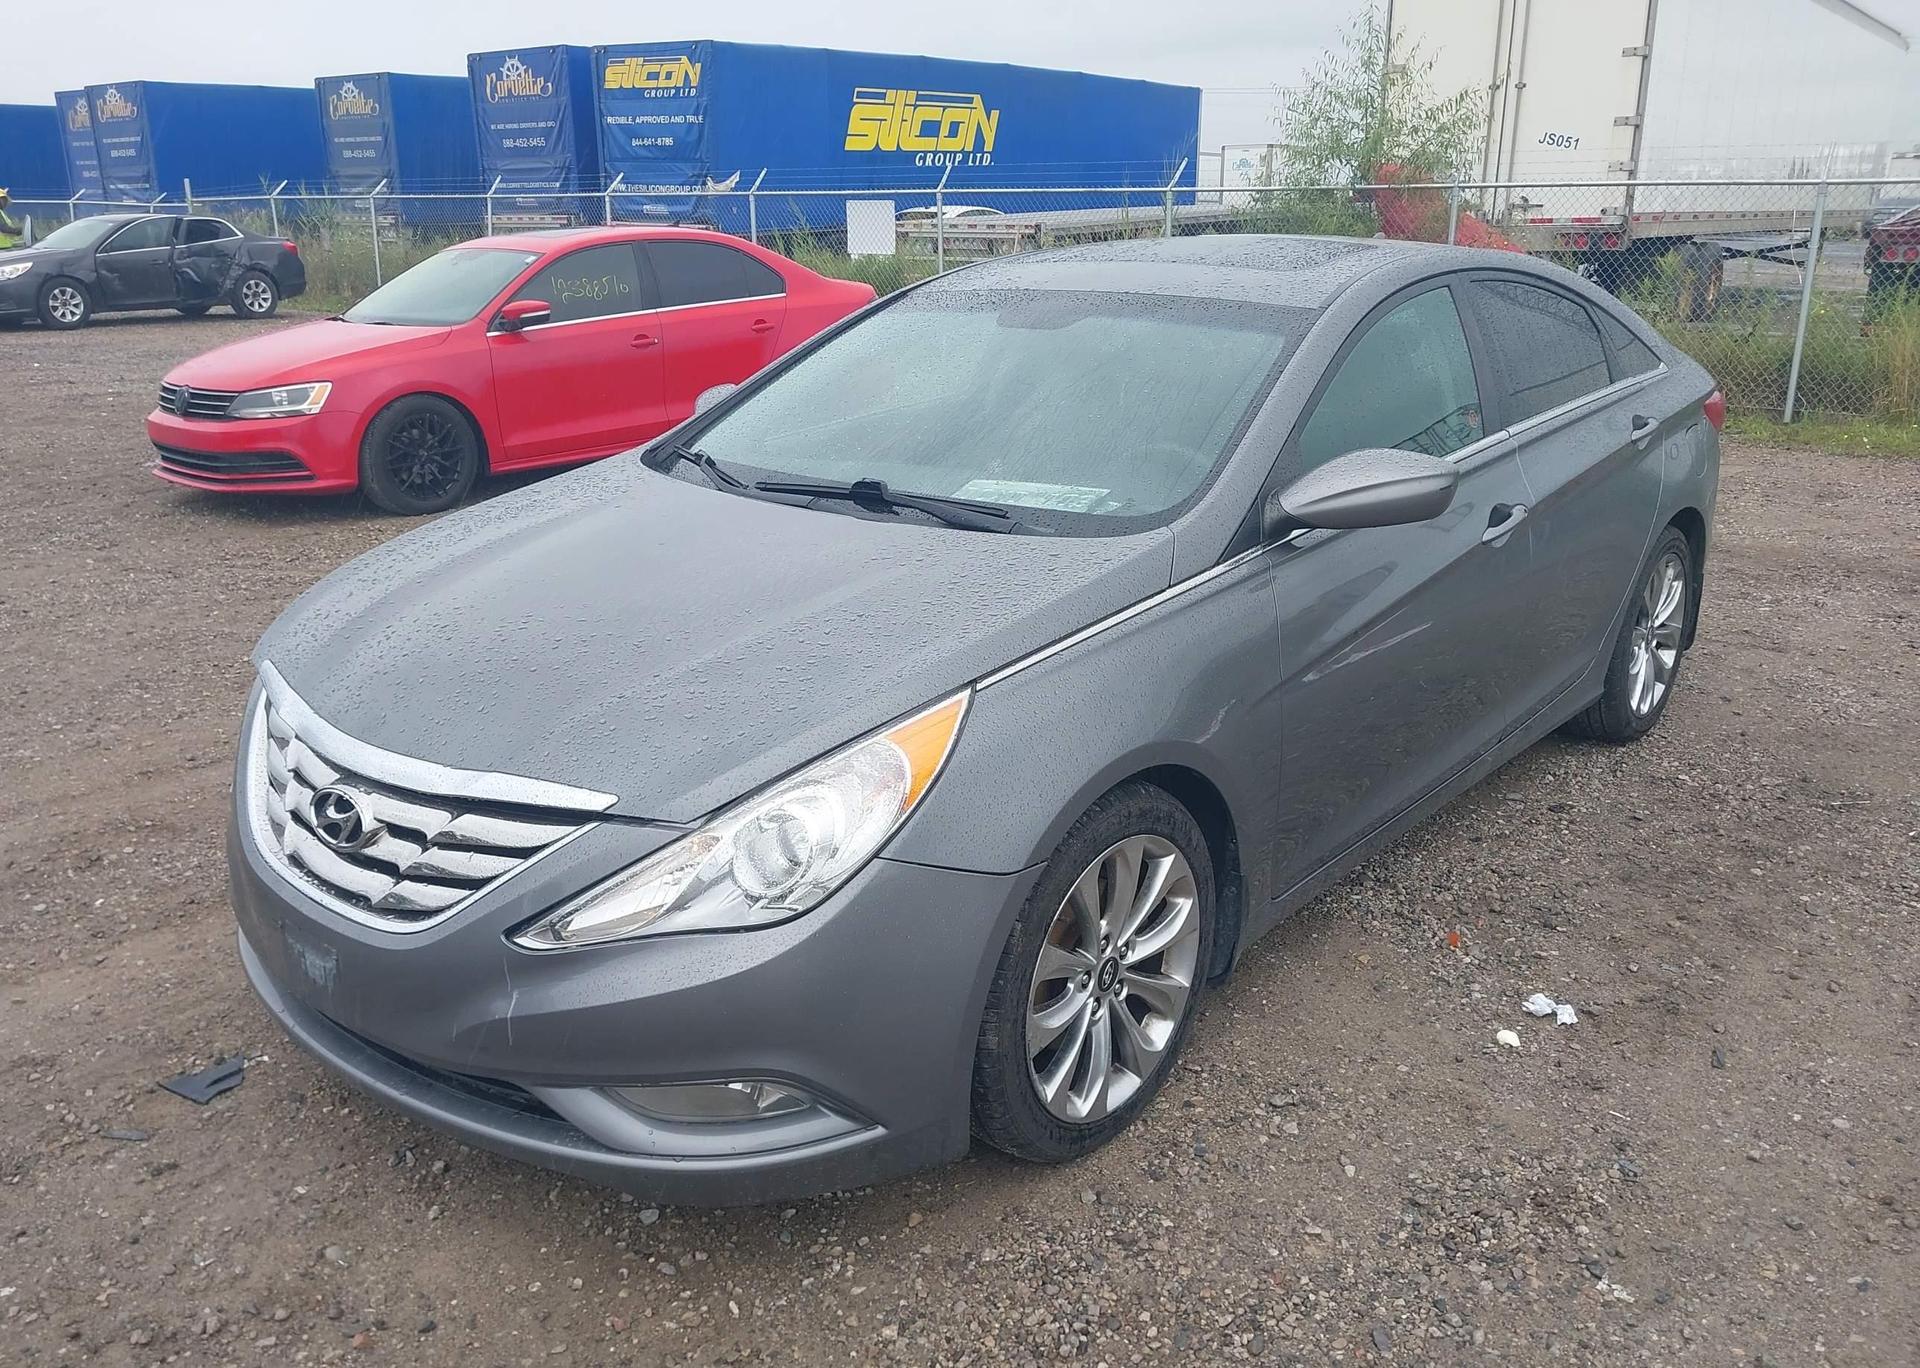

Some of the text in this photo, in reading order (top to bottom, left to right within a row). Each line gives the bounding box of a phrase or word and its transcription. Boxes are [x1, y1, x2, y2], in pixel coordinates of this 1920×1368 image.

[644, 88, 676, 98] GROUP
[605, 115, 634, 125] REDIBLE,
[635, 115, 671, 124] APPROVED
[671, 115, 685, 124] AND
[1538, 132, 1580, 150] JS051
[915, 152, 995, 166] GROUP LTD.
